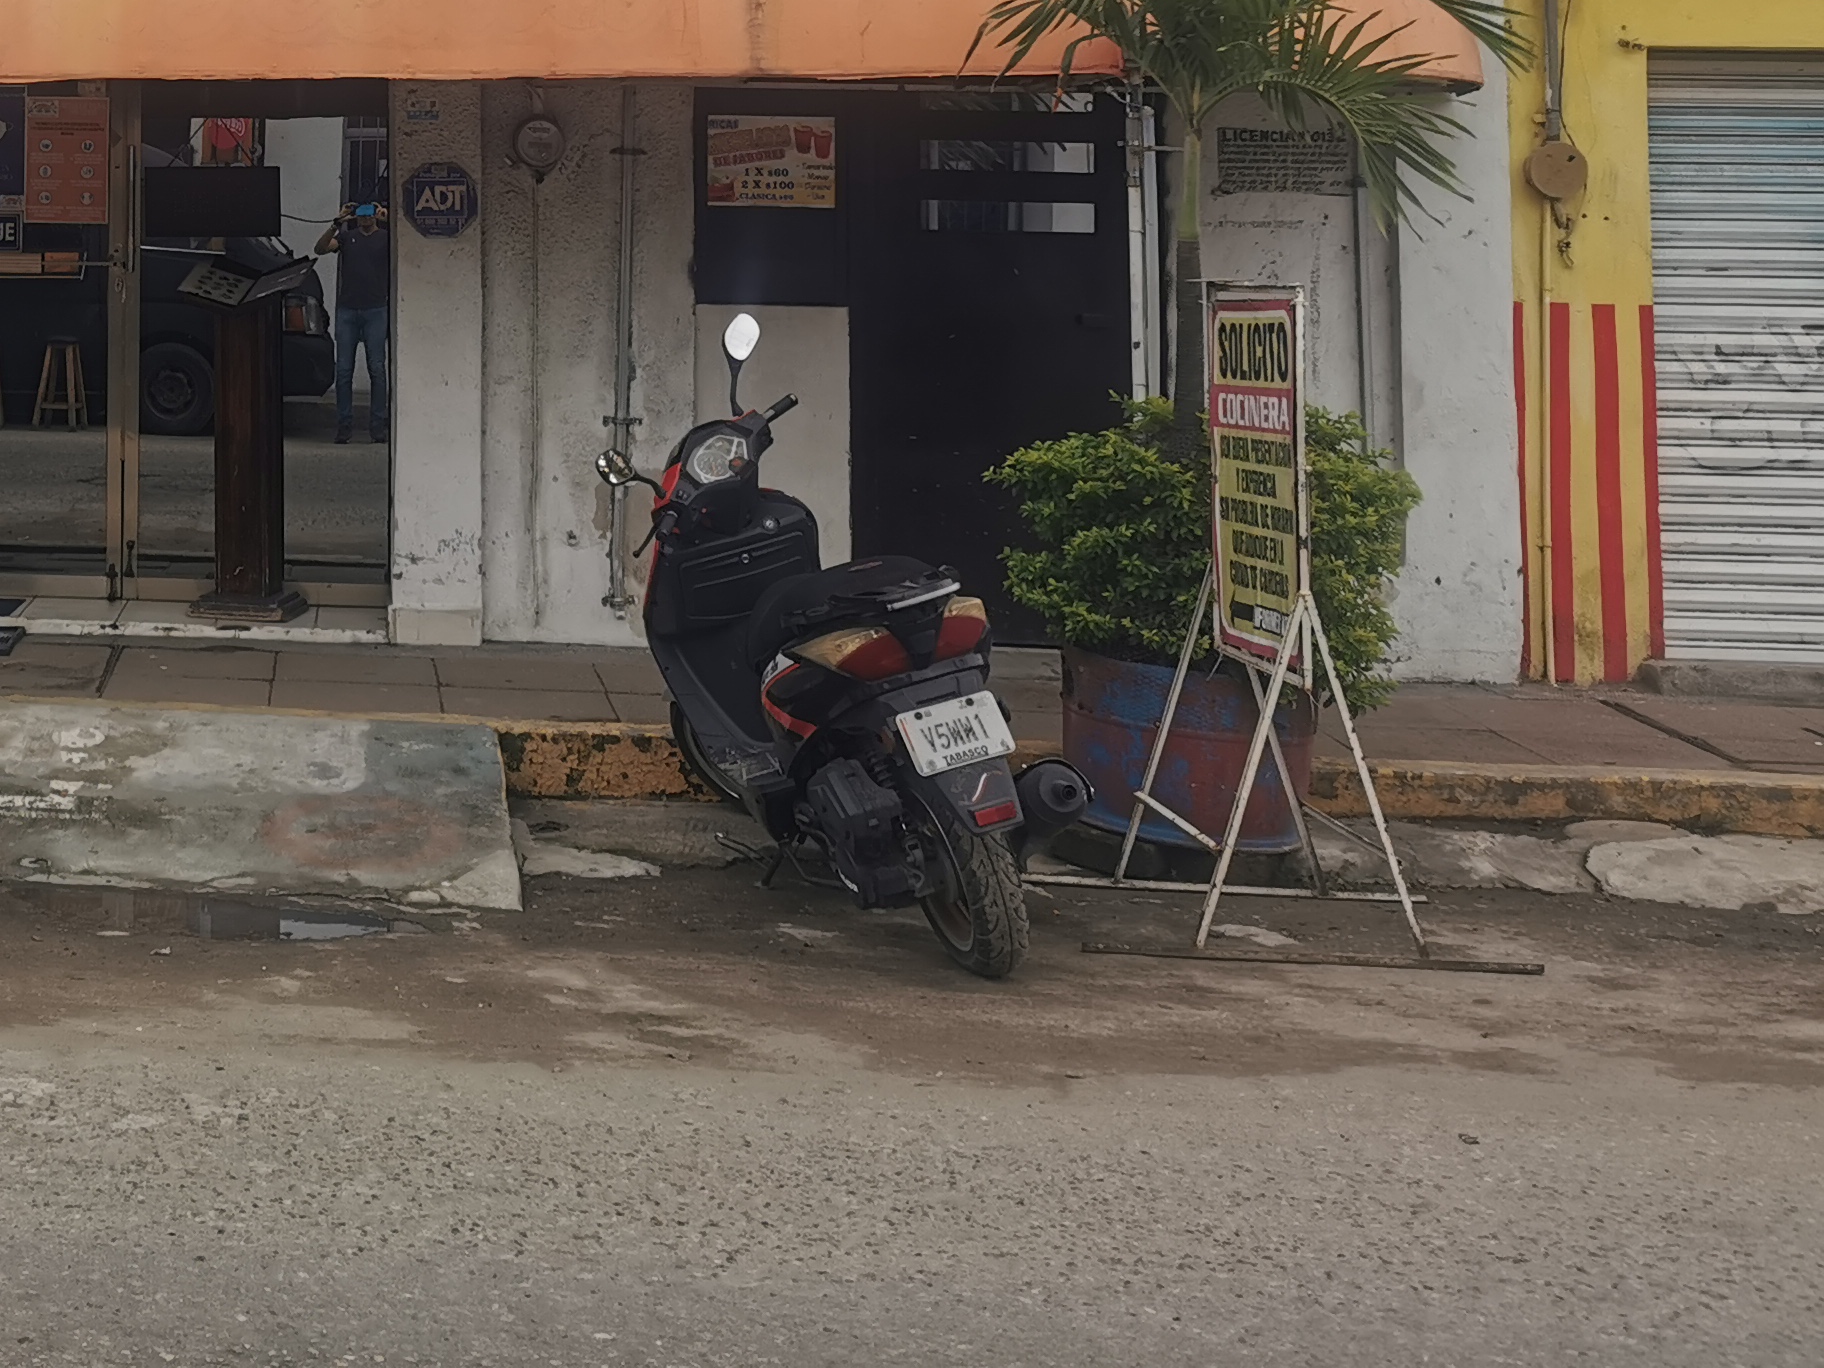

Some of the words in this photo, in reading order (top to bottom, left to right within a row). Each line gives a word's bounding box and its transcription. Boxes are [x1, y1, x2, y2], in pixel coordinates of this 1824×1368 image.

[1221, 130, 1296, 142] LICENCIA
[415, 185, 467, 211] ADT
[1218, 321, 1289, 384] SOLICITO
[1218, 392, 1290, 431] COCINERA
[941, 744, 989, 766] TABASCO
